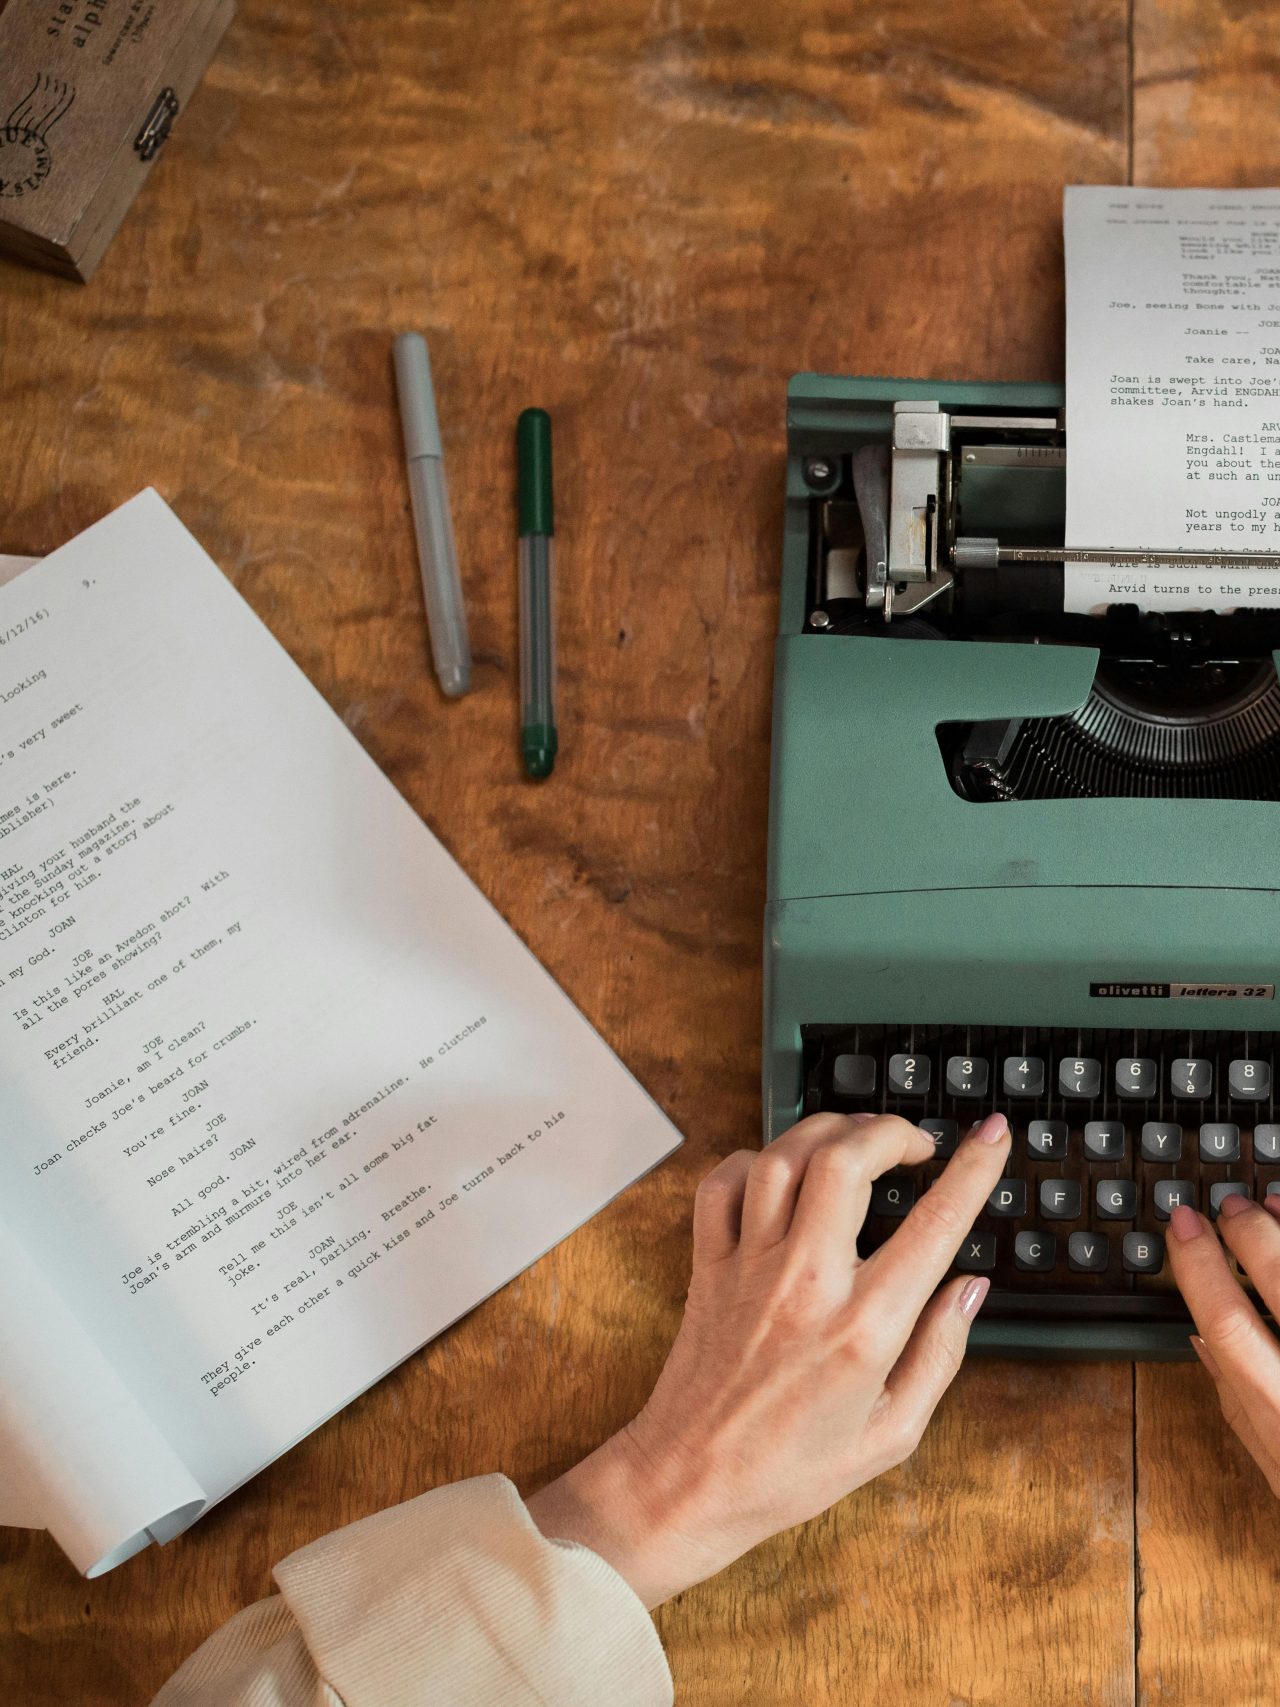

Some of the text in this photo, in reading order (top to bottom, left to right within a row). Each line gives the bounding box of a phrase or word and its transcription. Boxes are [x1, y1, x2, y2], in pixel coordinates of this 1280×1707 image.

[1184, 355, 1215, 364] Take
[1221, 357, 1256, 366] care,
[1110, 374, 1140, 383] Joan
[1147, 375, 1161, 384] is
[1169, 376, 1206, 386] swept
[1213, 376, 1243, 385] into
[1110, 385, 1182, 396] committee,
[1191, 387, 1228, 396] Arvid
[1110, 396, 1248, 407] shakes Joan's hand.
[1186, 433, 1214, 443] Mrs.
[1185, 509, 1208, 518] Not
[1215, 509, 1267, 522] ungodly
[1108, 583, 1146, 593] Arvid
[1153, 584, 1190, 594] turns
[1197, 585, 1213, 594] to
[1219, 584, 1242, 595] the
[18, 703, 84, 750] very sweet
[12, 1008, 29, 1021] Is
[32, 986, 61, 1007] this
[64, 966, 93, 986] like
[98, 953, 113, 965] an
[115, 923, 156, 953] Avedon
[200, 871, 230, 892] With
[43, 1033, 79, 1060] Every
[81, 991, 144, 1034] brilliant
[147, 974, 168, 990] one
[172, 959, 187, 974] of
[226, 921, 242, 935] my
[1098, 985, 1267, 997] olivetti lettera 32
[52, 1037, 99, 1069] friend.
[84, 1020, 206, 1109] Joanie, am I clean?
[905, 1059, 915, 1072] 2
[962, 1061, 972, 1074] 3
[1018, 1061, 1029, 1074] 4
[1074, 1062, 1084, 1075] 5
[1130, 1063, 1141, 1076] 6
[1187, 1063, 1196, 1076] 7
[1244, 1065, 1254, 1077] 8
[904, 1076, 913, 1089] é
[33, 1019, 257, 1176] Joan checks Joe's beard for crumbs.
[122, 1104, 202, 1157] You're fine.
[1042, 1133, 1052, 1146] R
[1099, 1134, 1109, 1147] T
[1157, 1134, 1167, 1148] Y
[1214, 1136, 1225, 1149] U
[1272, 1137, 1275, 1150] I
[146, 1133, 219, 1187] Nose hairs?
[171, 1175, 230, 1217] All good.
[218, 1115, 438, 1276] Tell me this isn't all some big fat
[887, 1189, 899, 1204] Q
[1000, 1191, 1012, 1205] D
[1055, 1192, 1065, 1205] F
[1111, 1193, 1122, 1205] G
[1169, 1193, 1179, 1206] H
[200, 1112, 560, 1385] They give each other a quick kiss and Joe turns back to his
[971, 1244, 981, 1257] X
[1029, 1244, 1040, 1257] C
[1084, 1246, 1094, 1258] V
[1138, 1245, 1148, 1258] B
[228, 1263, 260, 1288] joke.
[209, 1361, 256, 1398] people.
